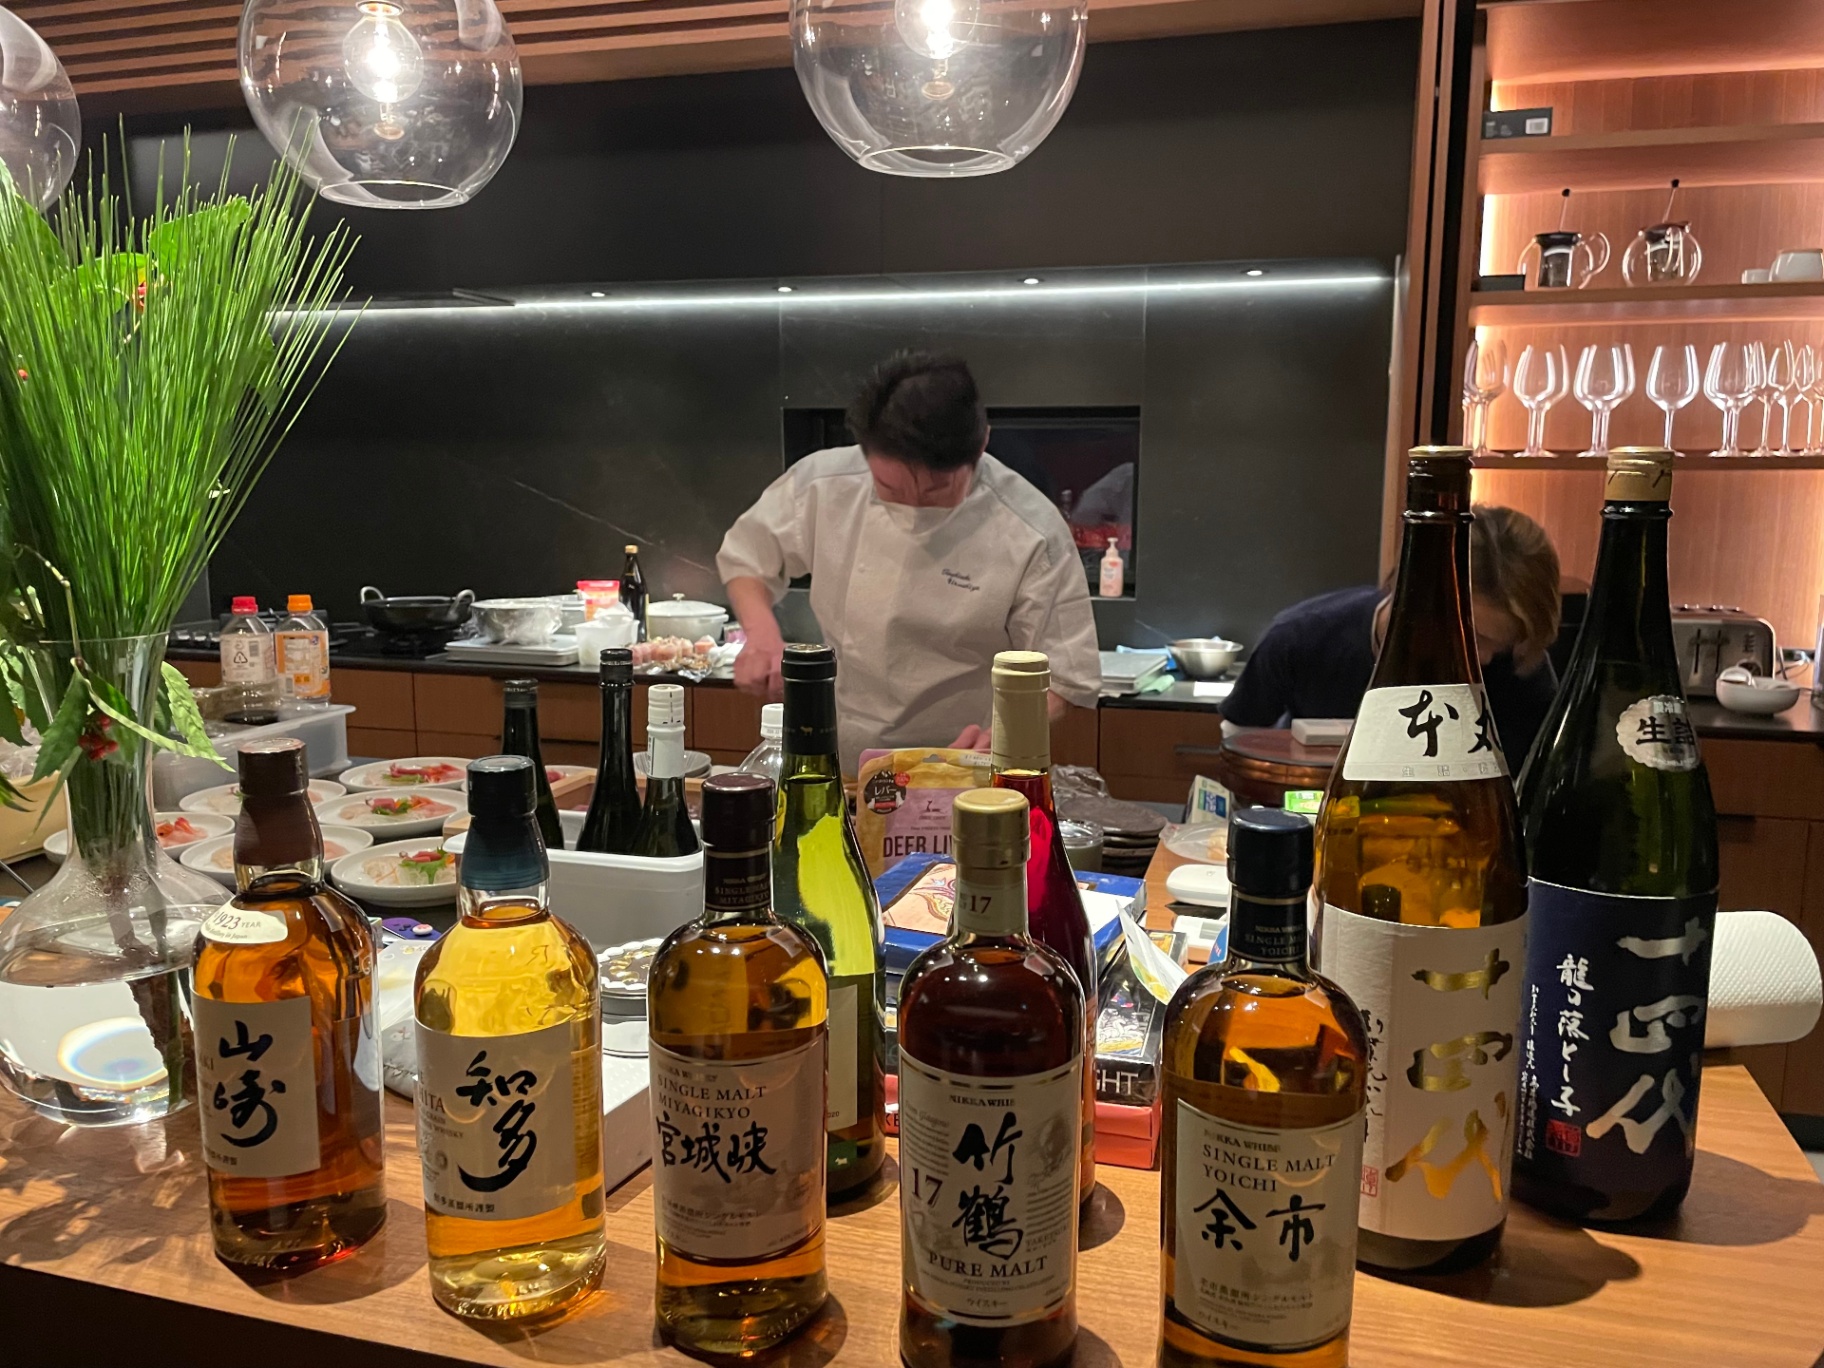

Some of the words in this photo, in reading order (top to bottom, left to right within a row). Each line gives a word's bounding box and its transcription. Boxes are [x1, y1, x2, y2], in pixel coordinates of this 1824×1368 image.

[969, 894, 992, 914] 17
[213, 911, 242, 930] 1923
[241, 921, 262, 929] YEAR
[657, 1074, 711, 1100] SINGLE
[716, 1086, 767, 1102] MALT
[658, 1092, 751, 1119] MIYAGIKYO
[455, 1050, 538, 1193] 知多
[1202, 1144, 1279, 1172] SINGLE
[1285, 1153, 1336, 1173] MALT
[911, 1167, 943, 1206] 17
[952, 1111, 1024, 1261] 竹鶴
[1202, 1163, 1278, 1193] YOICHI
[1193, 1188, 1326, 1262] 余市
[929, 1252, 983, 1278] PURE
[989, 1255, 1048, 1278] MALT
